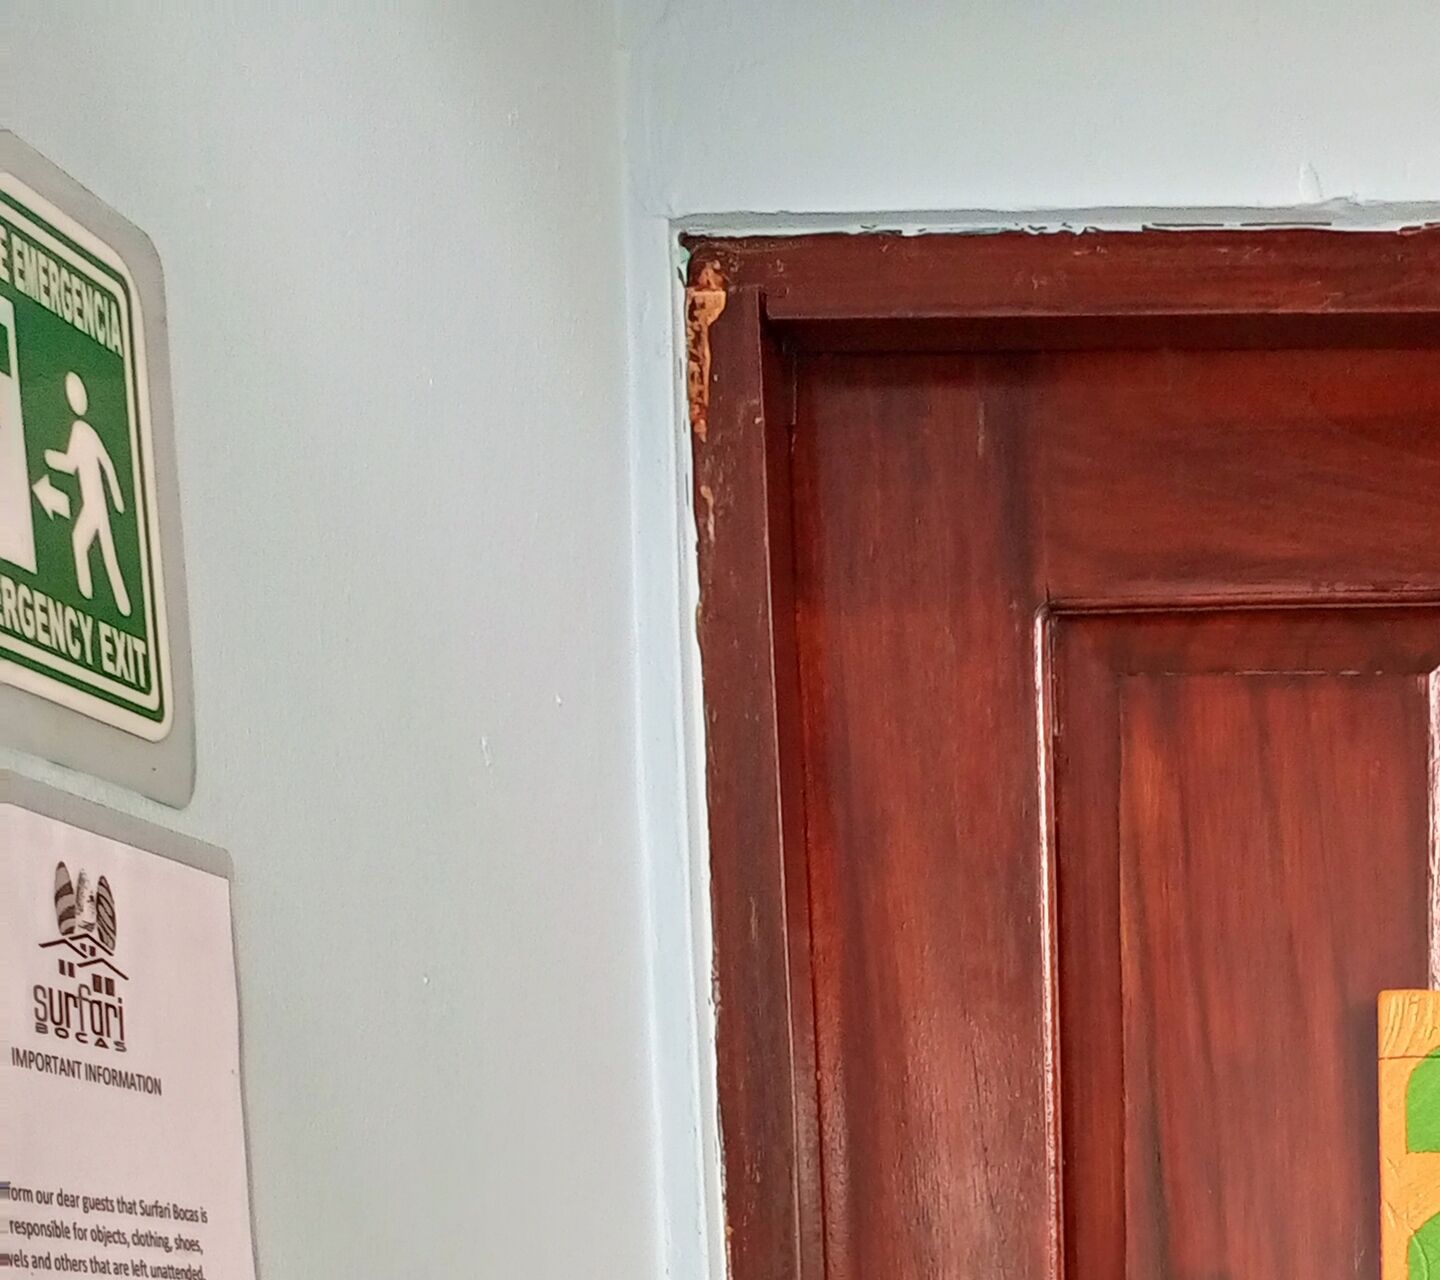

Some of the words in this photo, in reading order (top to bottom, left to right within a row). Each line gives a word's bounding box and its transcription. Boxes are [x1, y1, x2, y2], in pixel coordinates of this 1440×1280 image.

[11, 232, 124, 359] EMERGENCIA
[0, 575, 93, 666] RGENCY
[98, 620, 147, 688] EXIT
[35, 1022, 127, 1052] BOCAS
[11, 1047, 82, 1080] IMPORTANT
[84, 1063, 162, 1096] INFORMATION
[36, 1190, 54, 1206] our
[56, 1188, 80, 1208] dear
[82, 1195, 115, 1214] guests
[116, 1196, 137, 1216] that
[139, 1200, 171, 1219] Surfari
[172, 1203, 199, 1222] Bocas
[200, 1206, 208, 1224] is
[9, 1220, 71, 1240] responsible
[72, 1222, 88, 1241] for
[90, 1224, 130, 1248] objects,
[174, 1234, 203, 1255] shoes,
[31, 1252, 52, 1270] and
[54, 1253, 88, 1273] others
[89, 1256, 112, 1275] that
[112, 1261, 130, 1276] are
[130, 1259, 149, 1278] left
